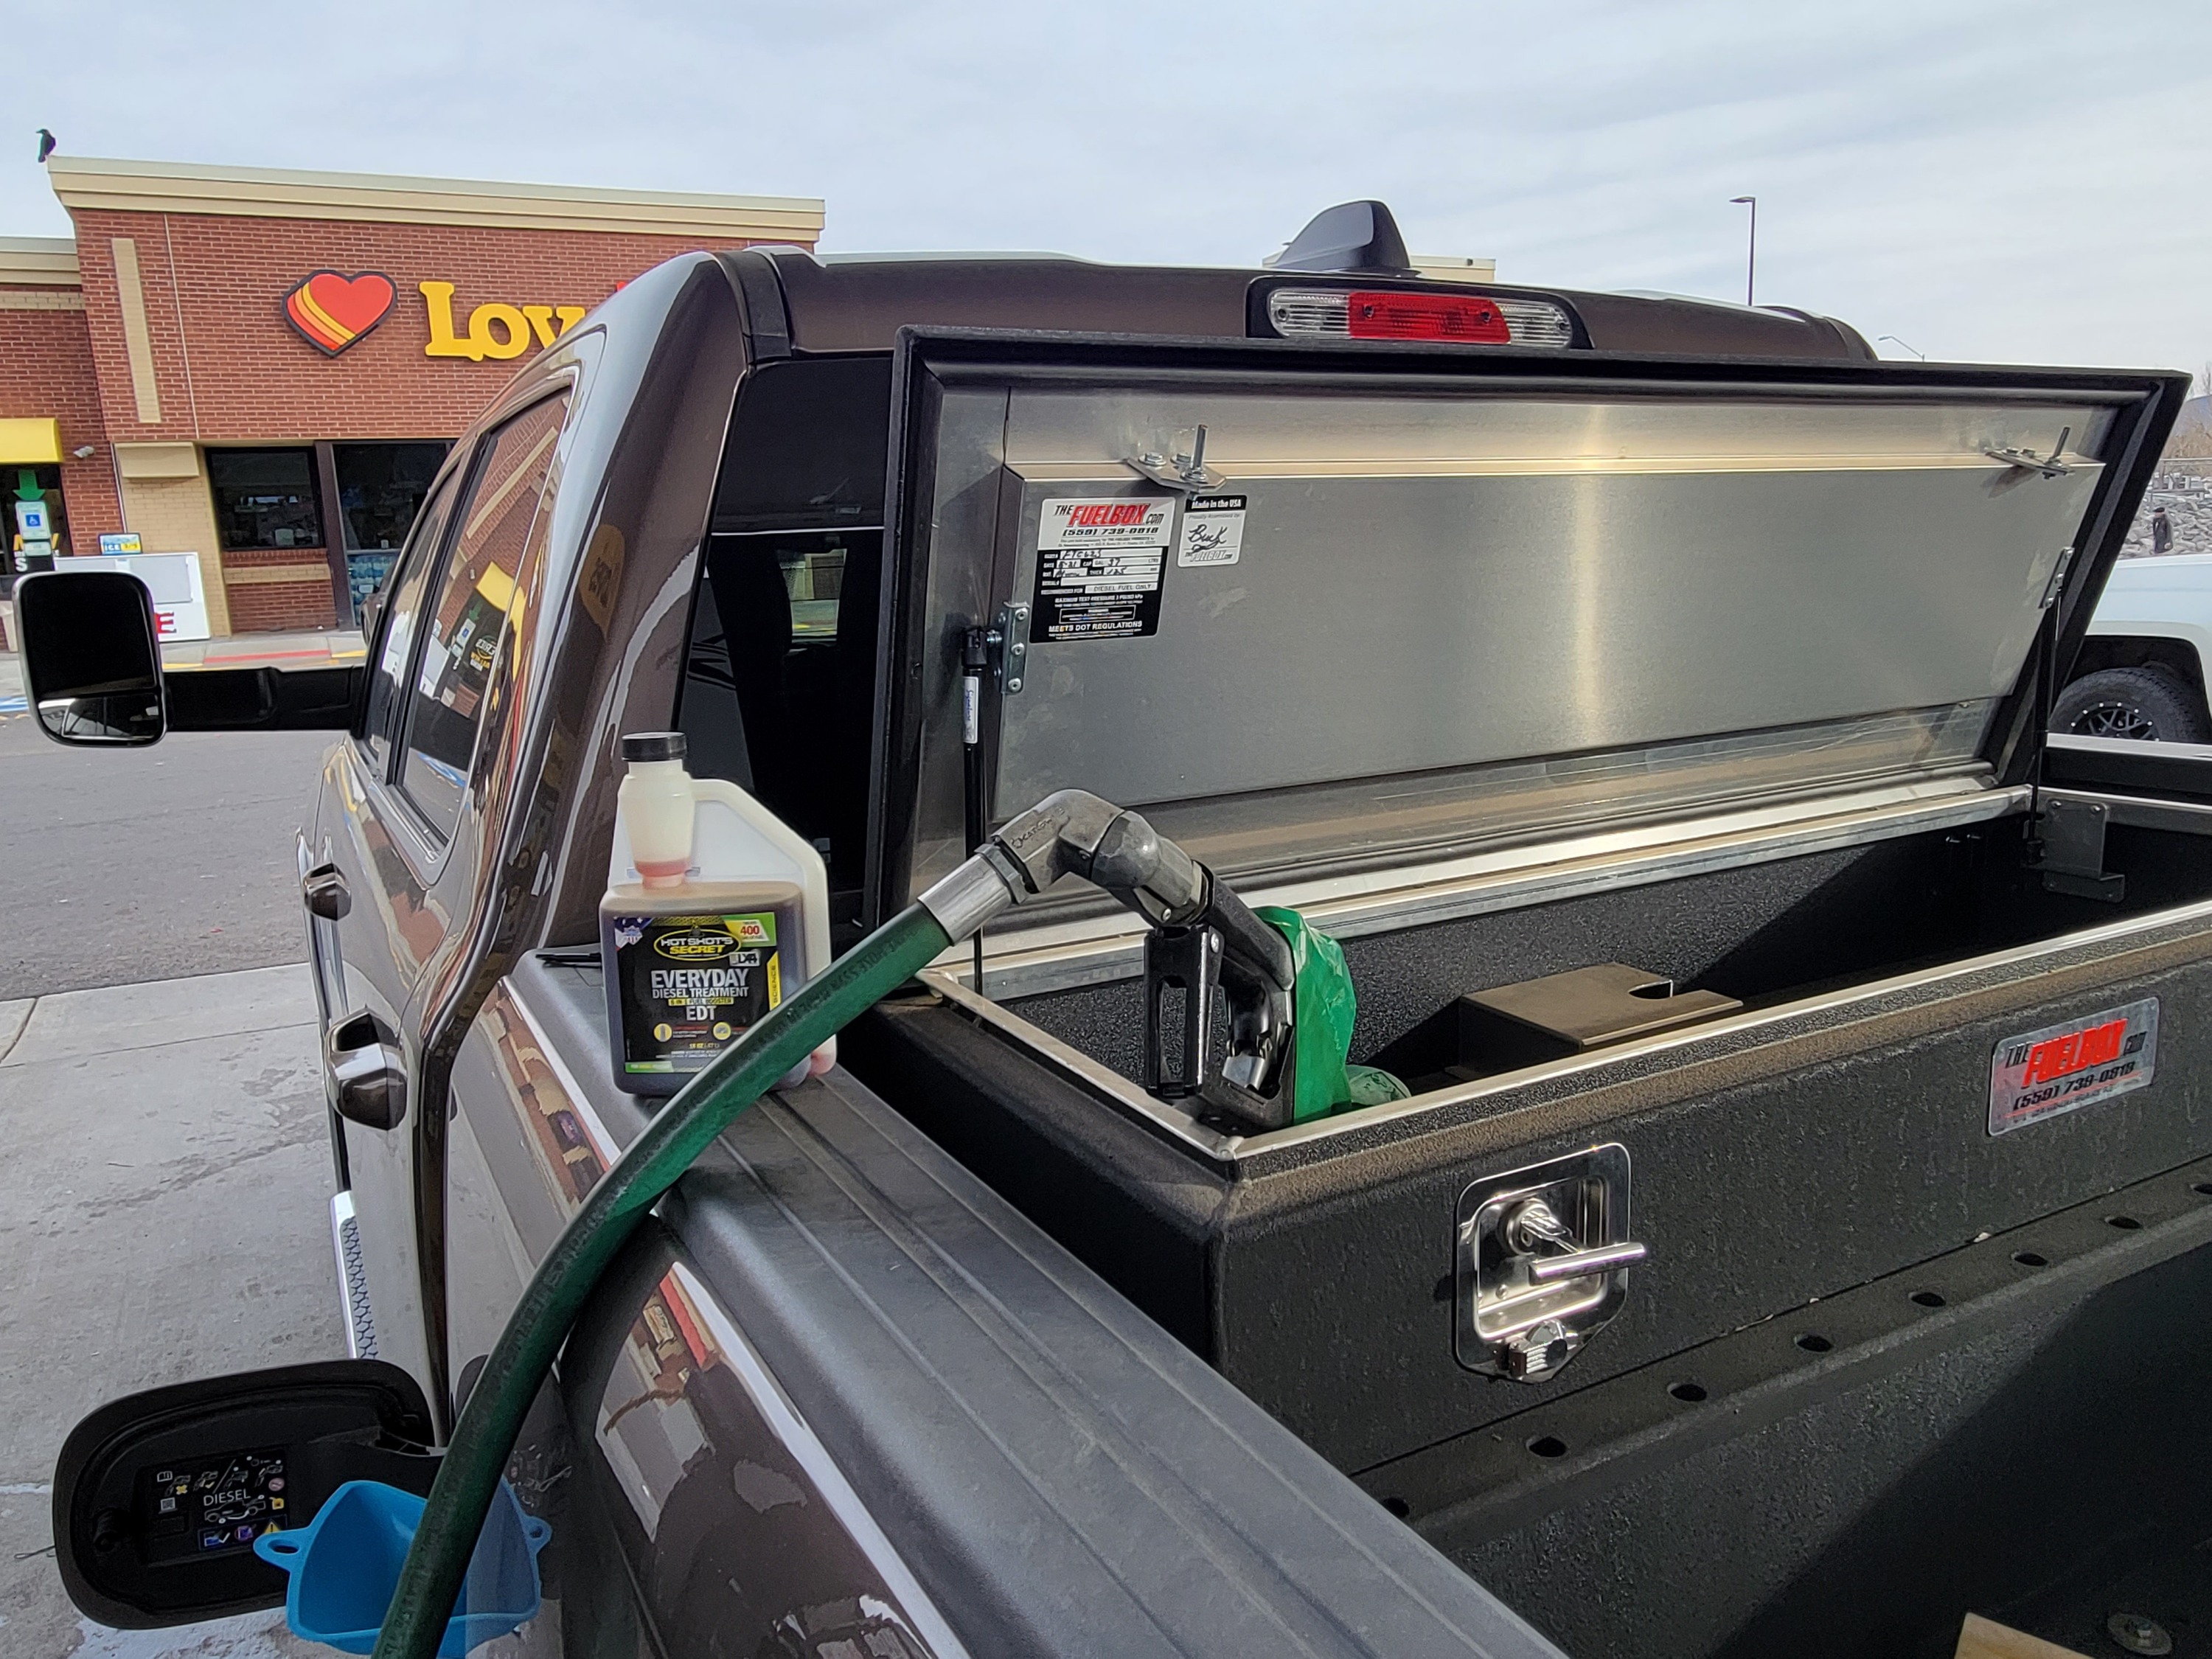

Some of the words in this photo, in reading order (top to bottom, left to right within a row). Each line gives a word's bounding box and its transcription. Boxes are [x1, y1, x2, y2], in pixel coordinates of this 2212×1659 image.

[419, 280, 586, 361] Lov
[1217, 499, 1228, 507] the
[1229, 498, 1241, 507] USA
[1054, 504, 1074, 515] THE
[1092, 621, 1142, 630] REGULATIONS
[740, 925, 760, 935] 400
[661, 938, 686, 947] HOT
[687, 936, 734, 945] SHOT'S
[669, 945, 726, 954] SECRET
[651, 968, 749, 989] EVERYDAY
[652, 988, 689, 999] DIESEL
[689, 987, 749, 998] TREATMENT
[686, 1006, 717, 1021] EDT
[2006, 1040, 2032, 1069] THE
[2013, 1084, 2059, 1112] (559)
[203, 1489, 251, 1507] DIESEL
